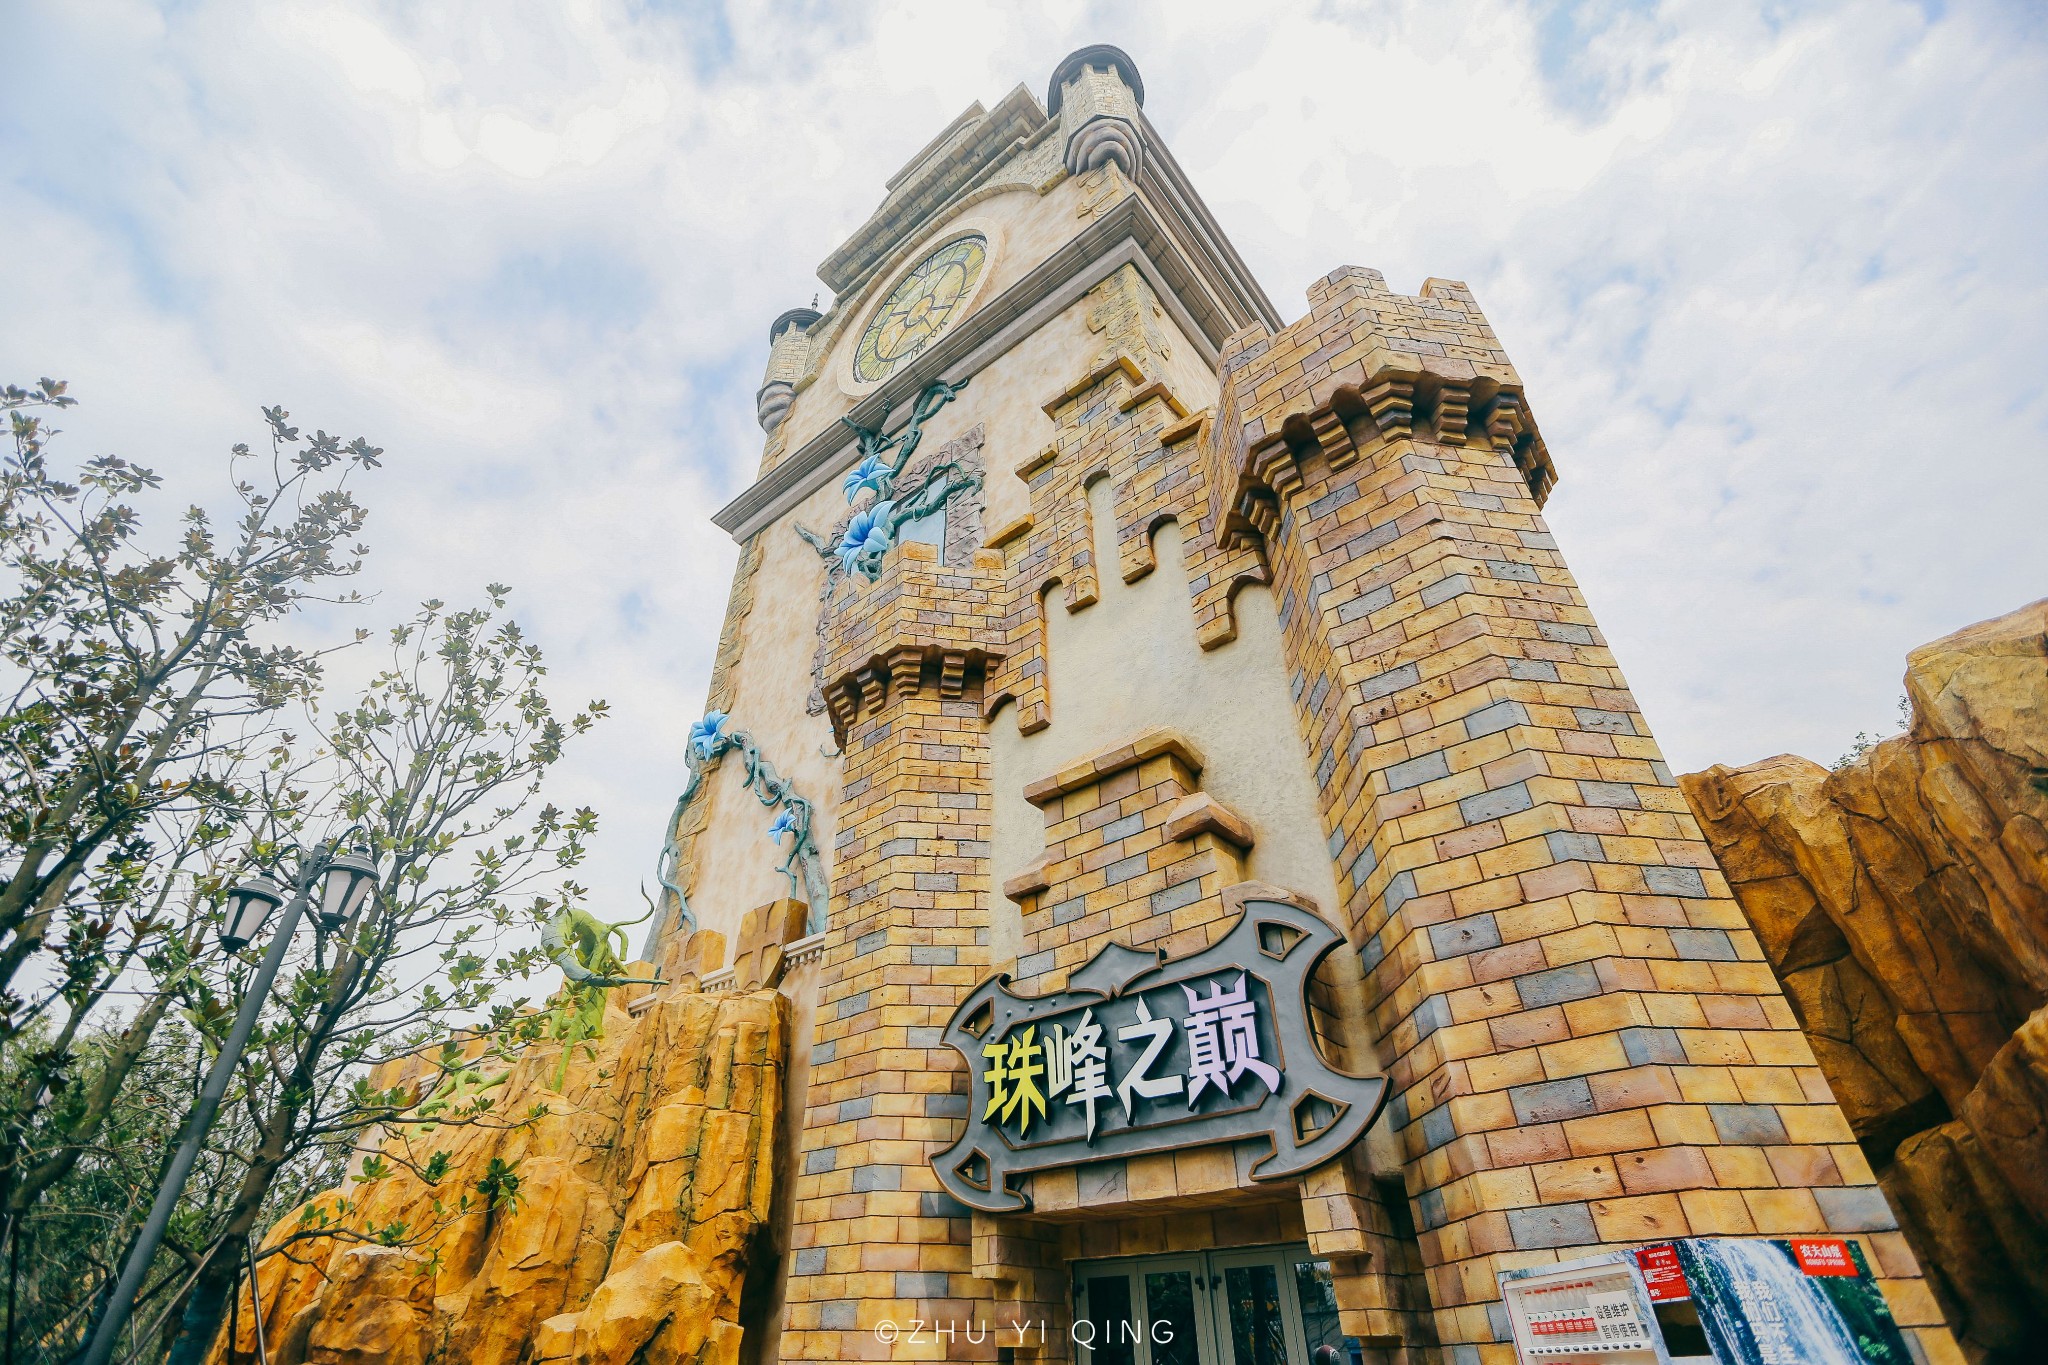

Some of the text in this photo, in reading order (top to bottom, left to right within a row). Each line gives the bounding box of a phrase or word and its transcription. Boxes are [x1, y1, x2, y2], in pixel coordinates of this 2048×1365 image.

[981, 971, 1283, 1146] 珠峰之巅
[1799, 1244, 1843, 1258] 农夫山泉
[1601, 1322, 1640, 1340] 暂停使用
